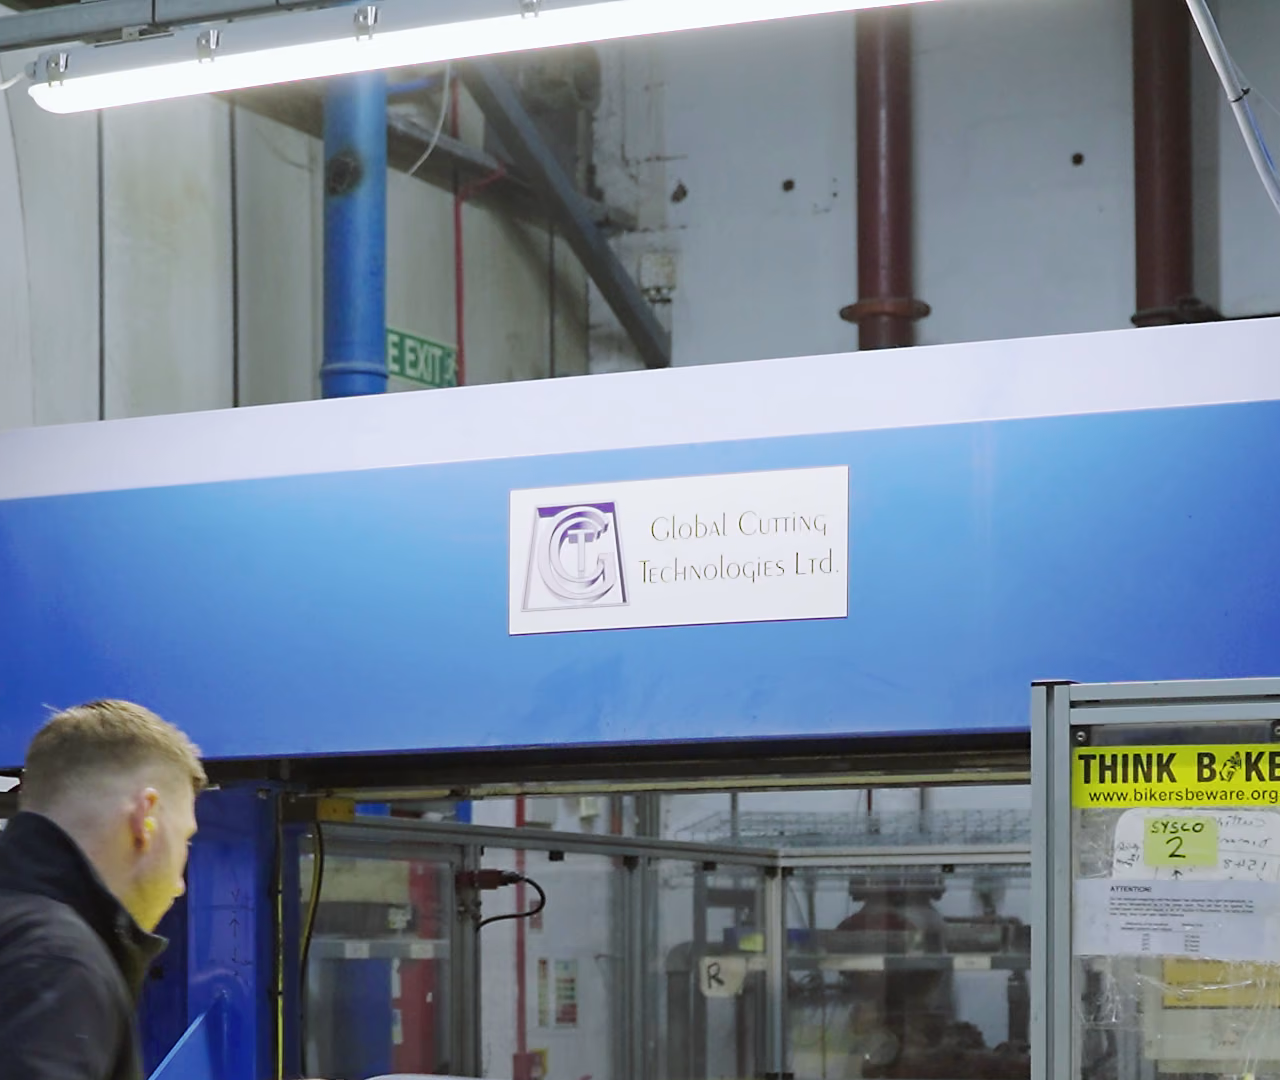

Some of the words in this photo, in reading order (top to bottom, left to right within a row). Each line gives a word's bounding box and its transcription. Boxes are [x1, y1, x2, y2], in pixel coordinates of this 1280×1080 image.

[405, 338, 442, 383] EXIT
[651, 512, 727, 542] Global
[738, 510, 827, 537] Cutting
[639, 554, 786, 584] Technologies
[794, 548, 839, 576] Ltd.
[1078, 752, 1177, 785] THINK
[1088, 787, 1279, 804] www.bikersbeware.org
[1150, 821, 1205, 834] SYSCO
[1165, 836, 1186, 859] 2
